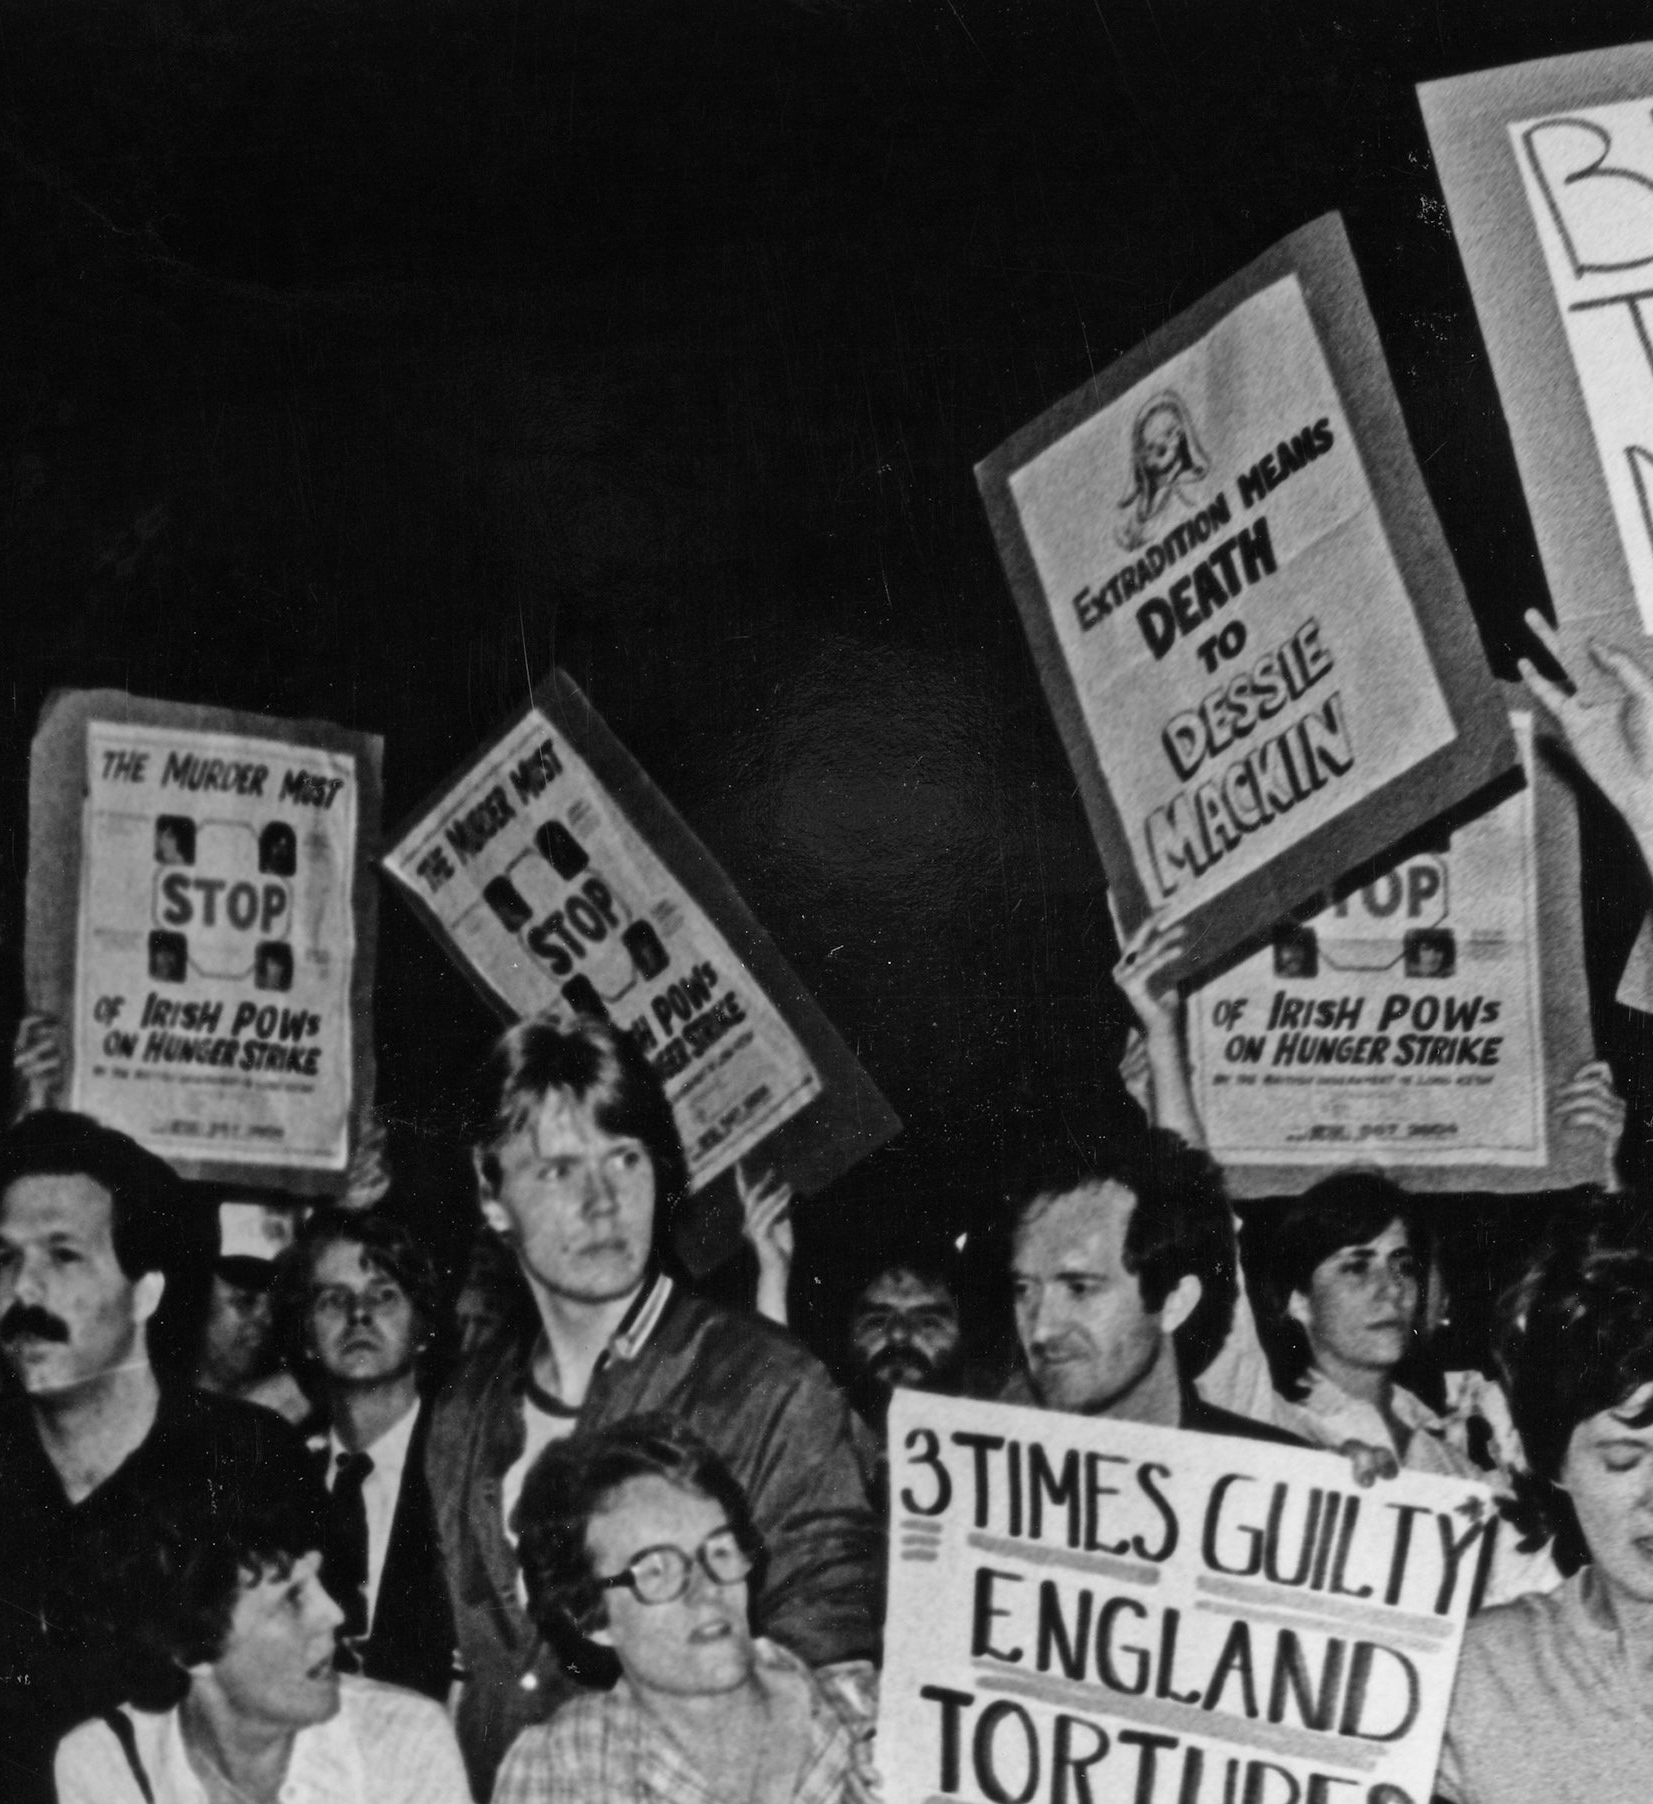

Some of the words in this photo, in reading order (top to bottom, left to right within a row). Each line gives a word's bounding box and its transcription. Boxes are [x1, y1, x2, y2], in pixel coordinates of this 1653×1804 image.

[1071, 491, 1232, 633] EXTRADITION
[1236, 417, 1336, 510] MEANS
[1134, 516, 1279, 660] DEATH
[1196, 619, 1248, 674] TO
[1160, 616, 1336, 783] DESSIE
[101, 749, 150, 784] THE
[160, 750, 270, 798] MURDER
[1142, 691, 1355, 898] MACKIN
[161, 872, 288, 934] STOP
[526, 876, 620, 977] STOP
[93, 995, 126, 1027] OF
[139, 990, 224, 1034] IRISH
[1212, 997, 1249, 1032] OF
[1266, 990, 1366, 1033] IRISH
[1224, 1034, 1267, 1065] ON
[1271, 1031, 1392, 1068] HUNGER
[1391, 1033, 1505, 1068] STRIKE
[103, 1029, 140, 1059] ON
[142, 1030, 241, 1068] HUNGER
[238, 1038, 323, 1077] STRIKE
[899, 1427, 953, 1518] 3
[950, 1430, 1181, 1563] TIMES
[1201, 1472, 1488, 1616] GUILTY
[971, 1565, 1420, 1743] ENGLAND
